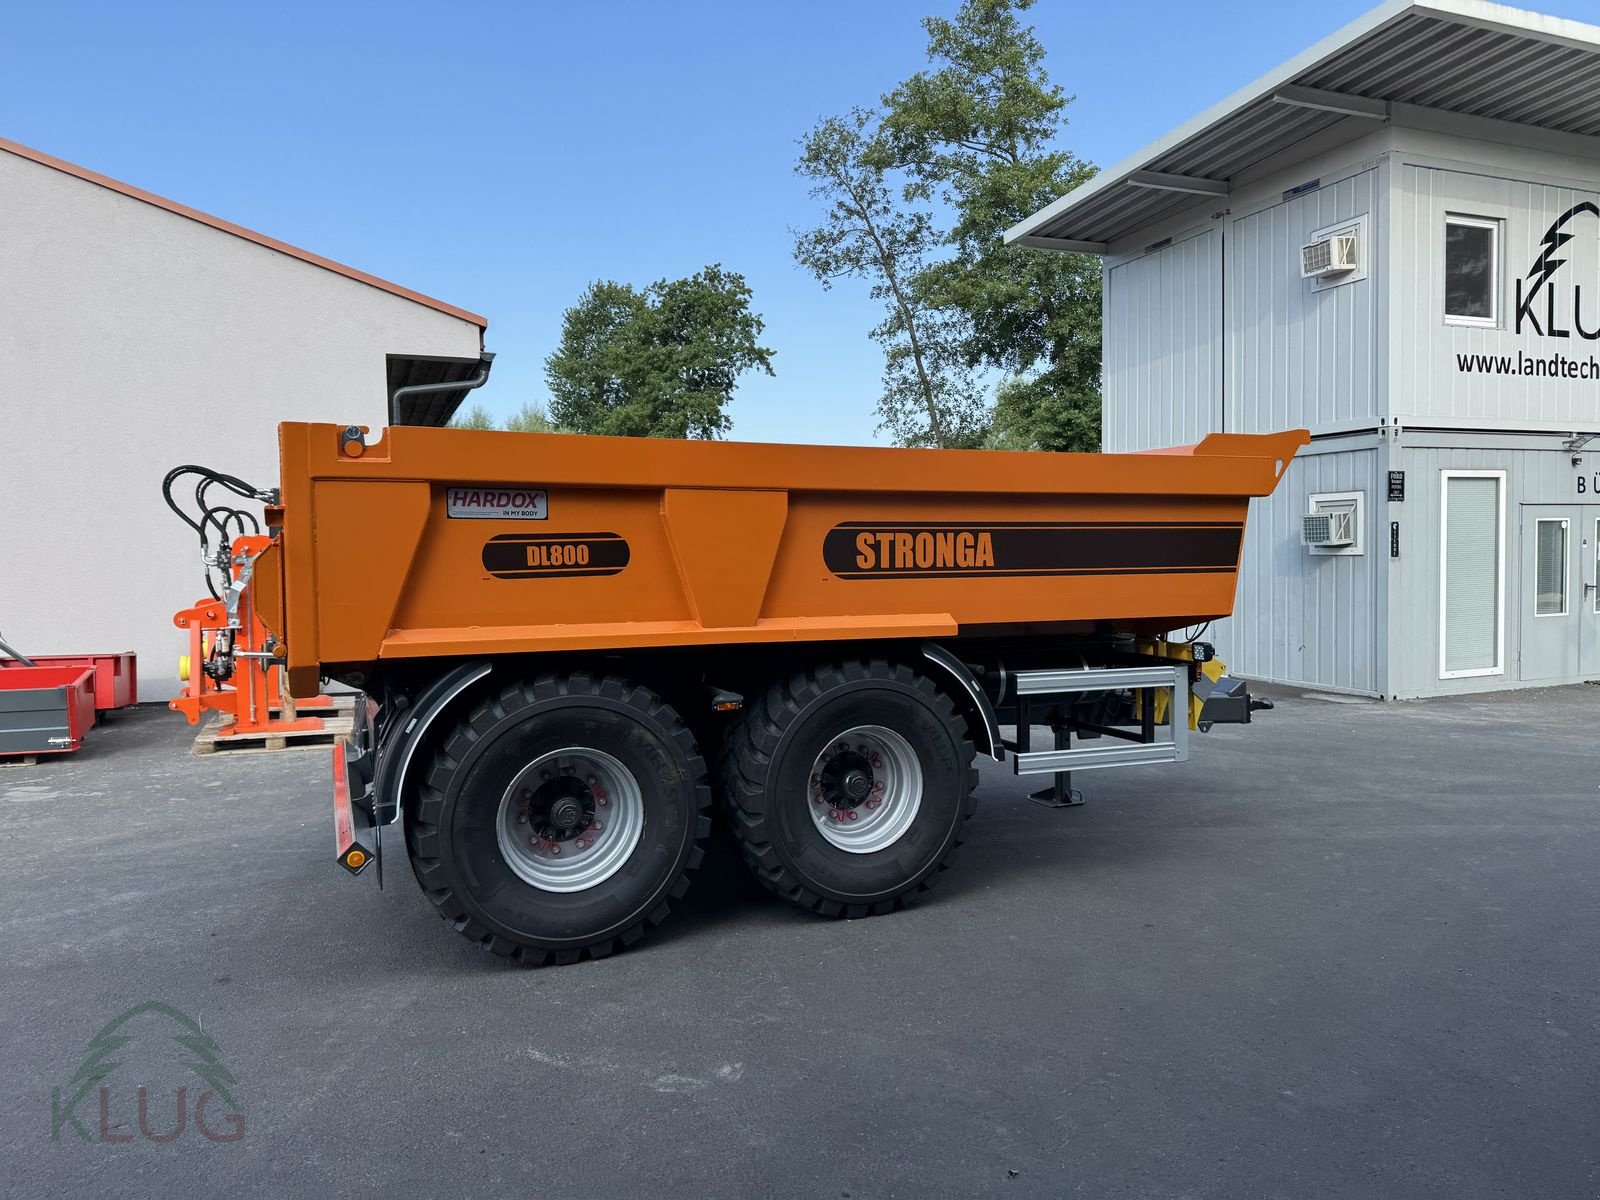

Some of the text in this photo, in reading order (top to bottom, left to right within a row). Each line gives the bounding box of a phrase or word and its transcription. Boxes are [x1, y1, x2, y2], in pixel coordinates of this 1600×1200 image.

[1456, 350, 1600, 380] www.landtech
[452, 491, 538, 509] HARDOX
[526, 544, 589, 567] DL800
[855, 531, 995, 570] STRONGA
